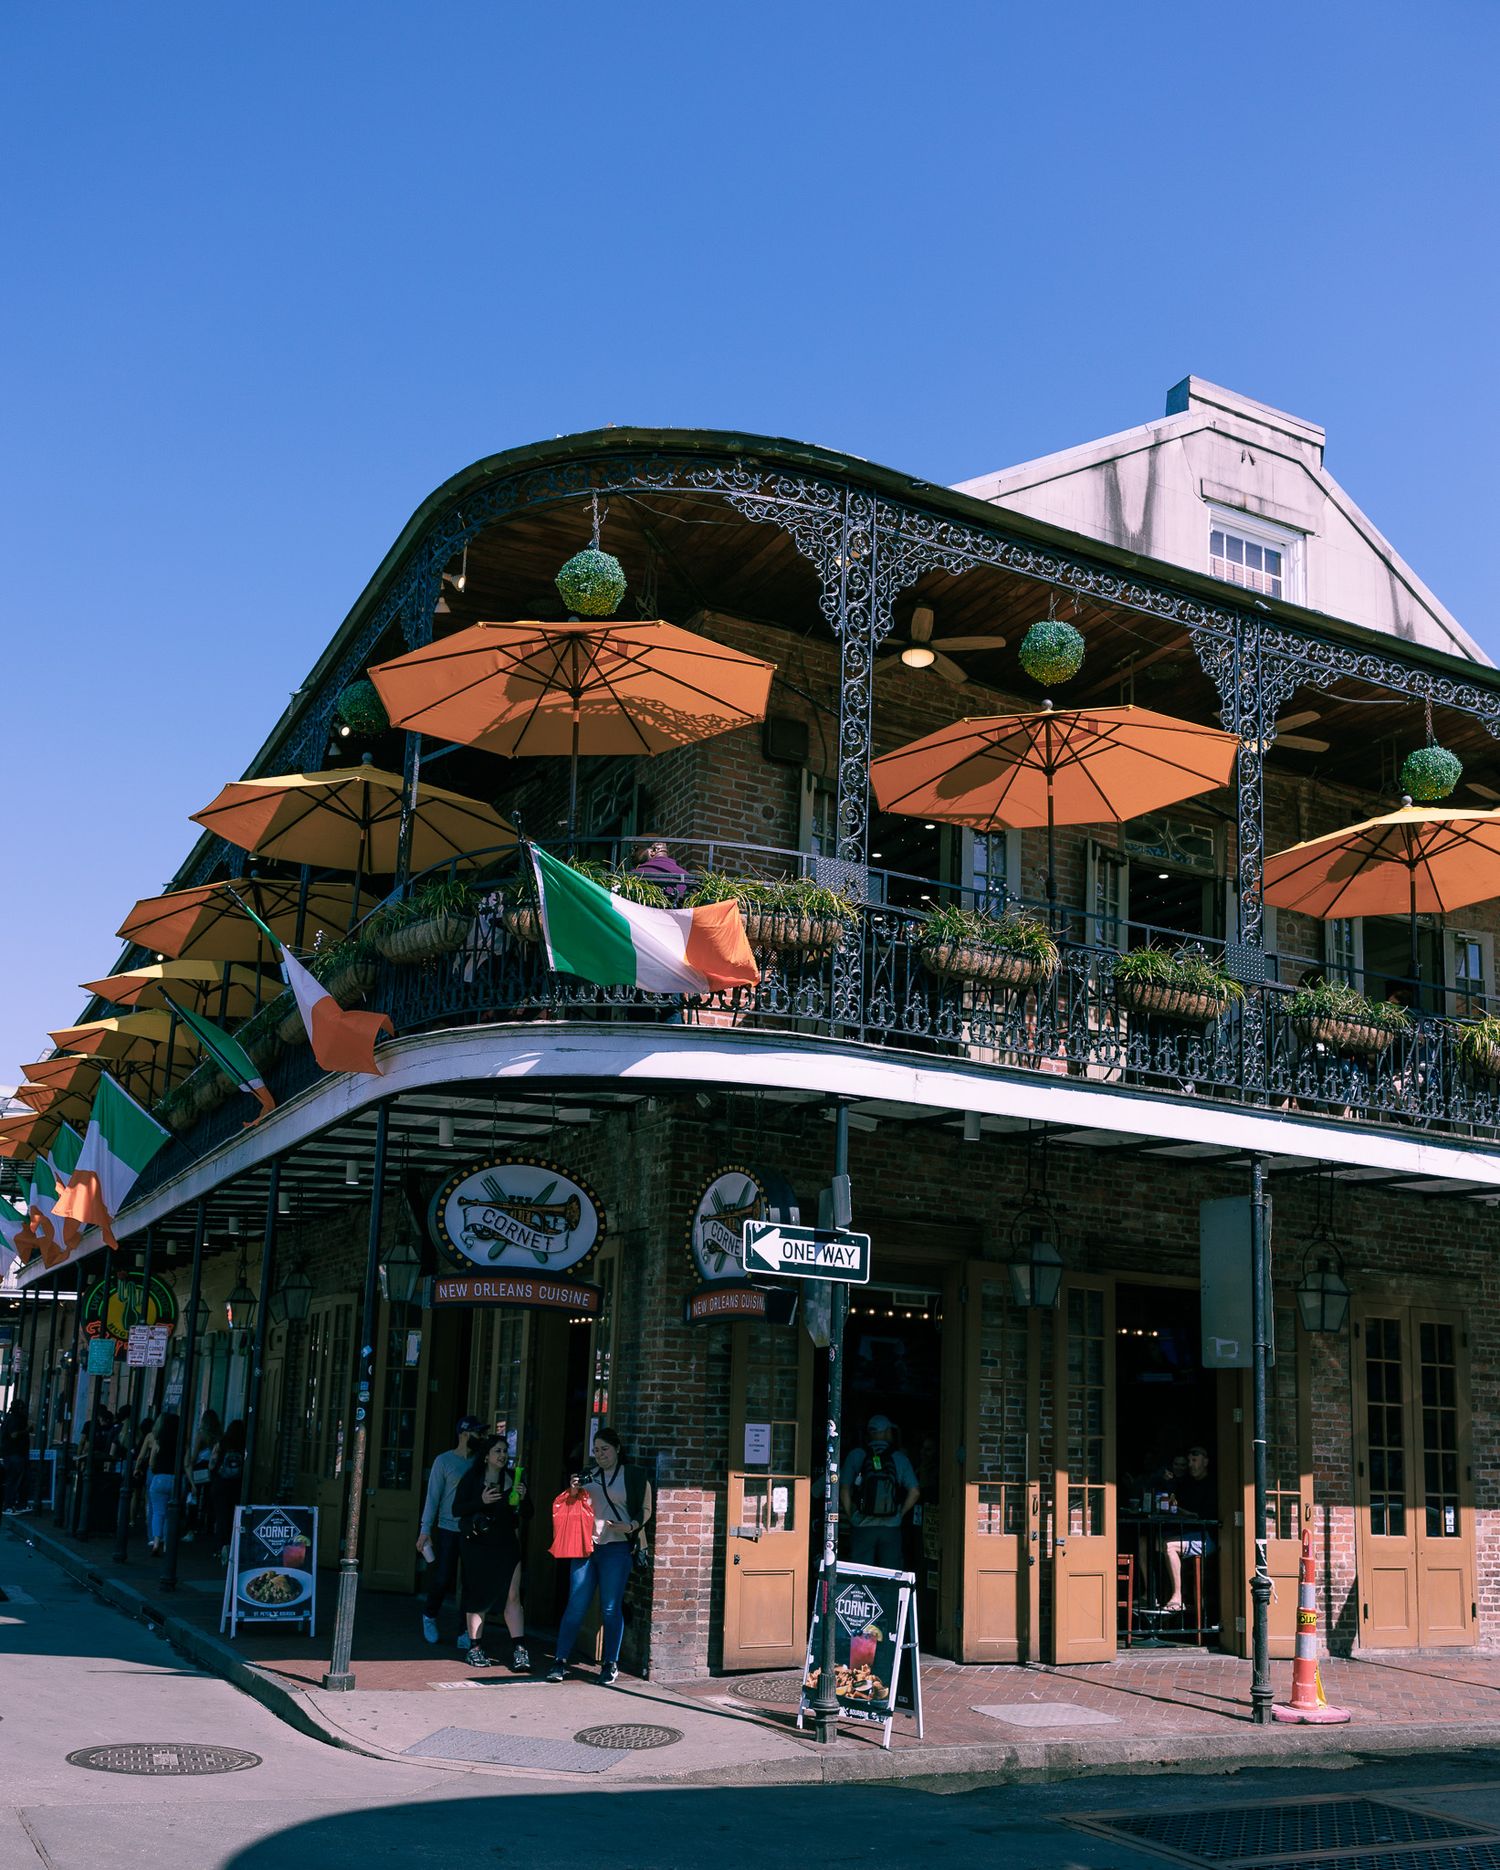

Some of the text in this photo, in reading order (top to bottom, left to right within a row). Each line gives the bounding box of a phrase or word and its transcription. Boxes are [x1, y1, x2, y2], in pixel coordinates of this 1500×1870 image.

[482, 1208, 555, 1251] CORNET
[711, 1222, 742, 1255] CORNE
[782, 1241, 856, 1266] ONE WAY
[439, 1283, 591, 1307] NEW ORLEANS CUISINE
[693, 1299, 708, 1316] NEW
[710, 1294, 739, 1312] ORLEANS
[108, 1323, 127, 1338] HUG
[259, 1525, 296, 1538] CORNET
[838, 1599, 877, 1619] CORNET
